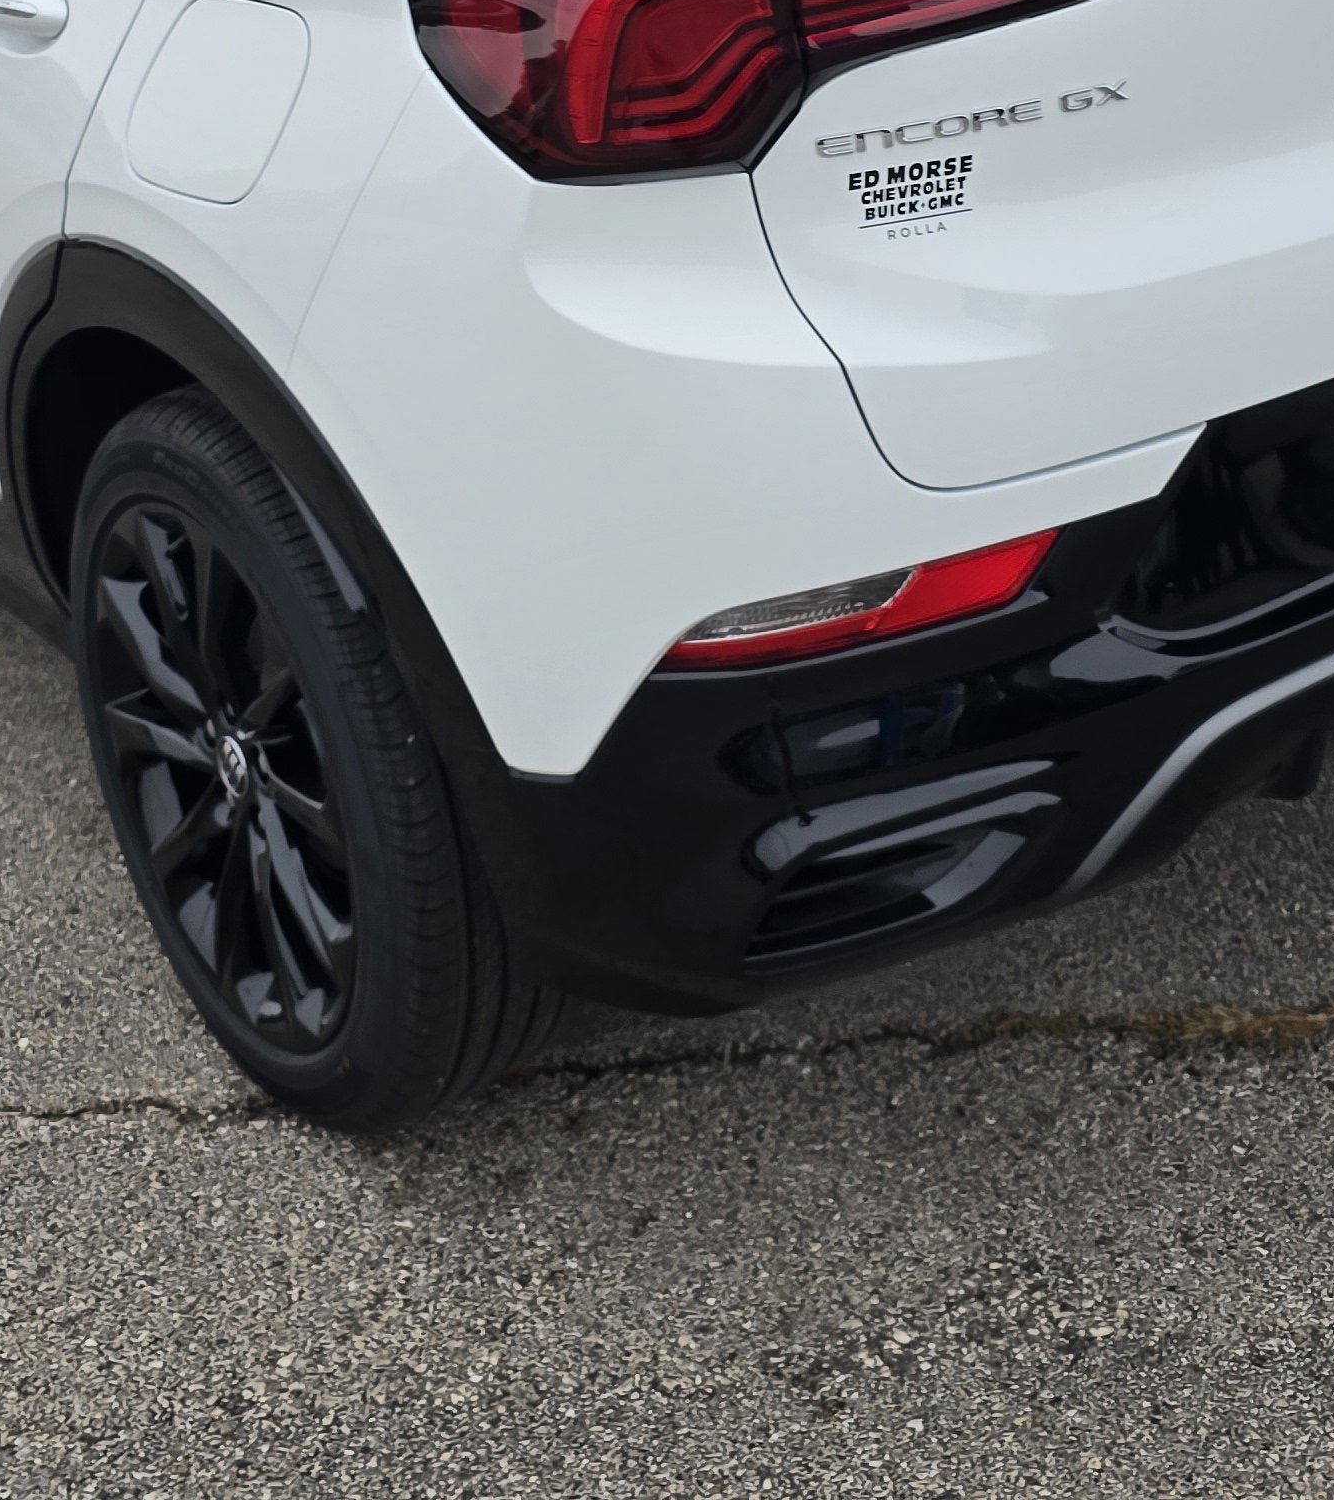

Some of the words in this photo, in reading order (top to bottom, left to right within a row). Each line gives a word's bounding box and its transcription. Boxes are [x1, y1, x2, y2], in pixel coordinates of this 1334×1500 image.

[814, 99, 1044, 157] ENCORE
[1059, 78, 1130, 113] GX
[848, 169, 880, 191] ED
[886, 154, 974, 185] MORSE
[860, 175, 967, 206] CHEVROLET
[886, 221, 948, 241] ROLLA
